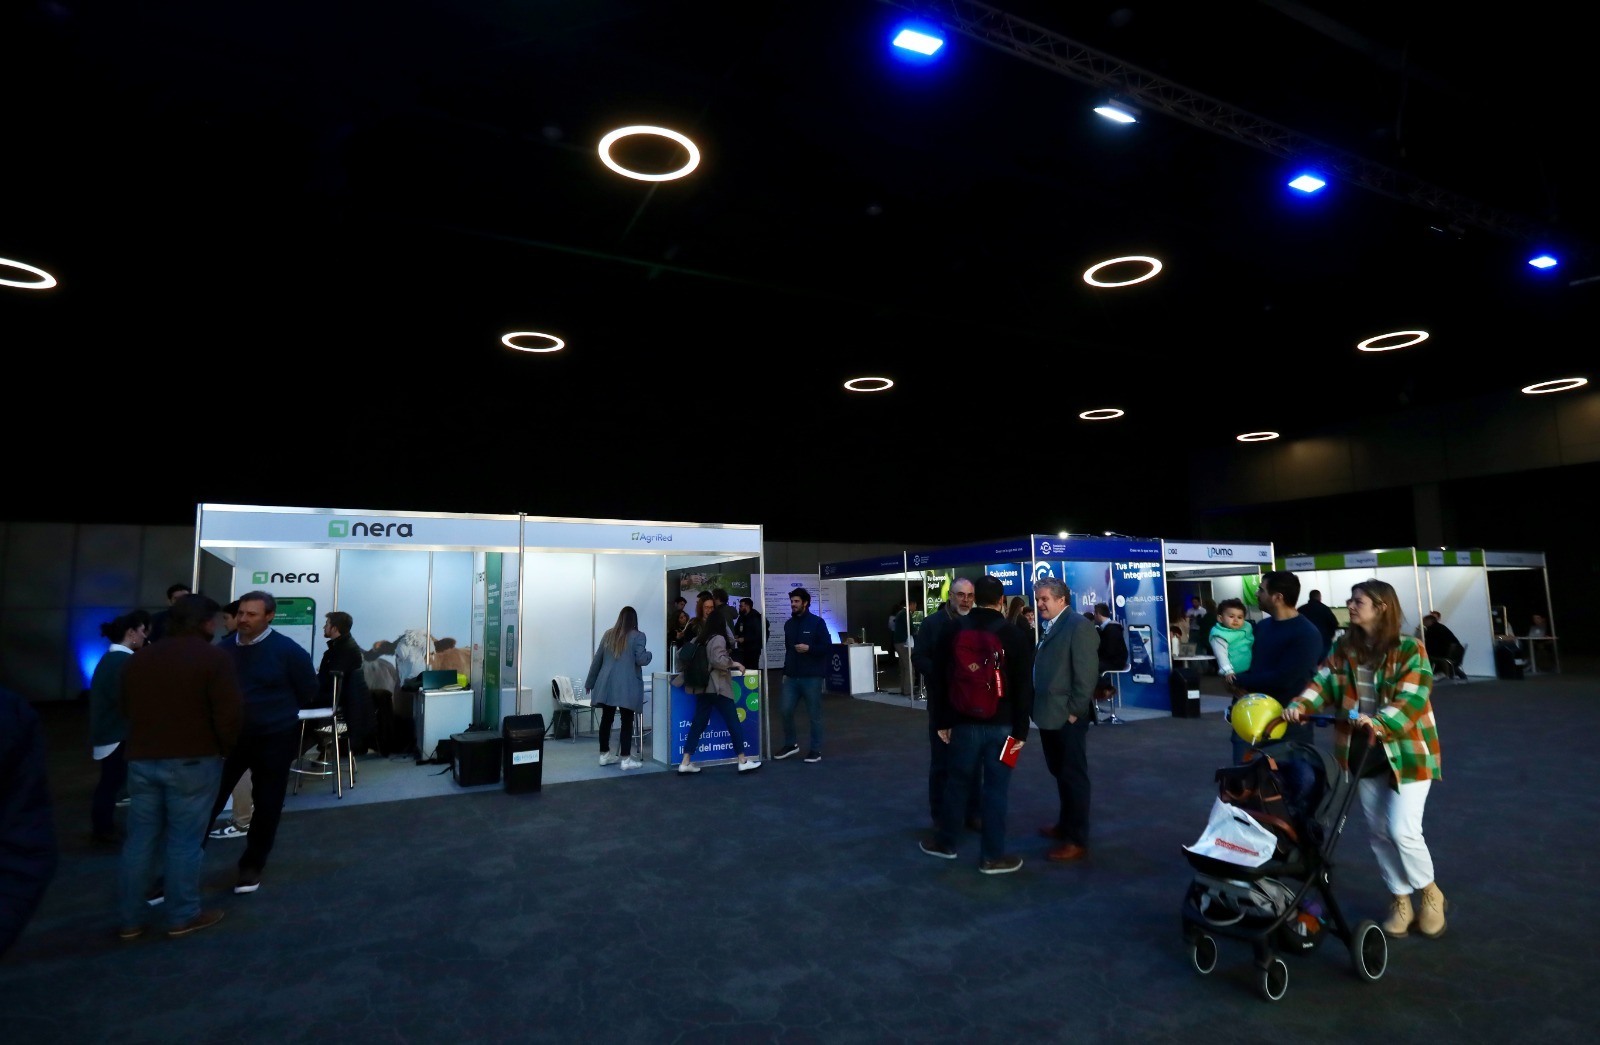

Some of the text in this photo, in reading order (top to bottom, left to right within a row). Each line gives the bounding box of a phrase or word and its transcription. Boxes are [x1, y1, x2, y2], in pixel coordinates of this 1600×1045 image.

[352, 522, 413, 537] nera
[640, 533, 673, 543] AgriRed
[1129, 561, 1160, 570] Finanzas
[270, 572, 320, 583] nera
[990, 569, 1018, 577] Soluciones
[1123, 570, 1161, 580] Integradas
[699, 743, 711, 752] del
[713, 741, 750, 752] merco.
